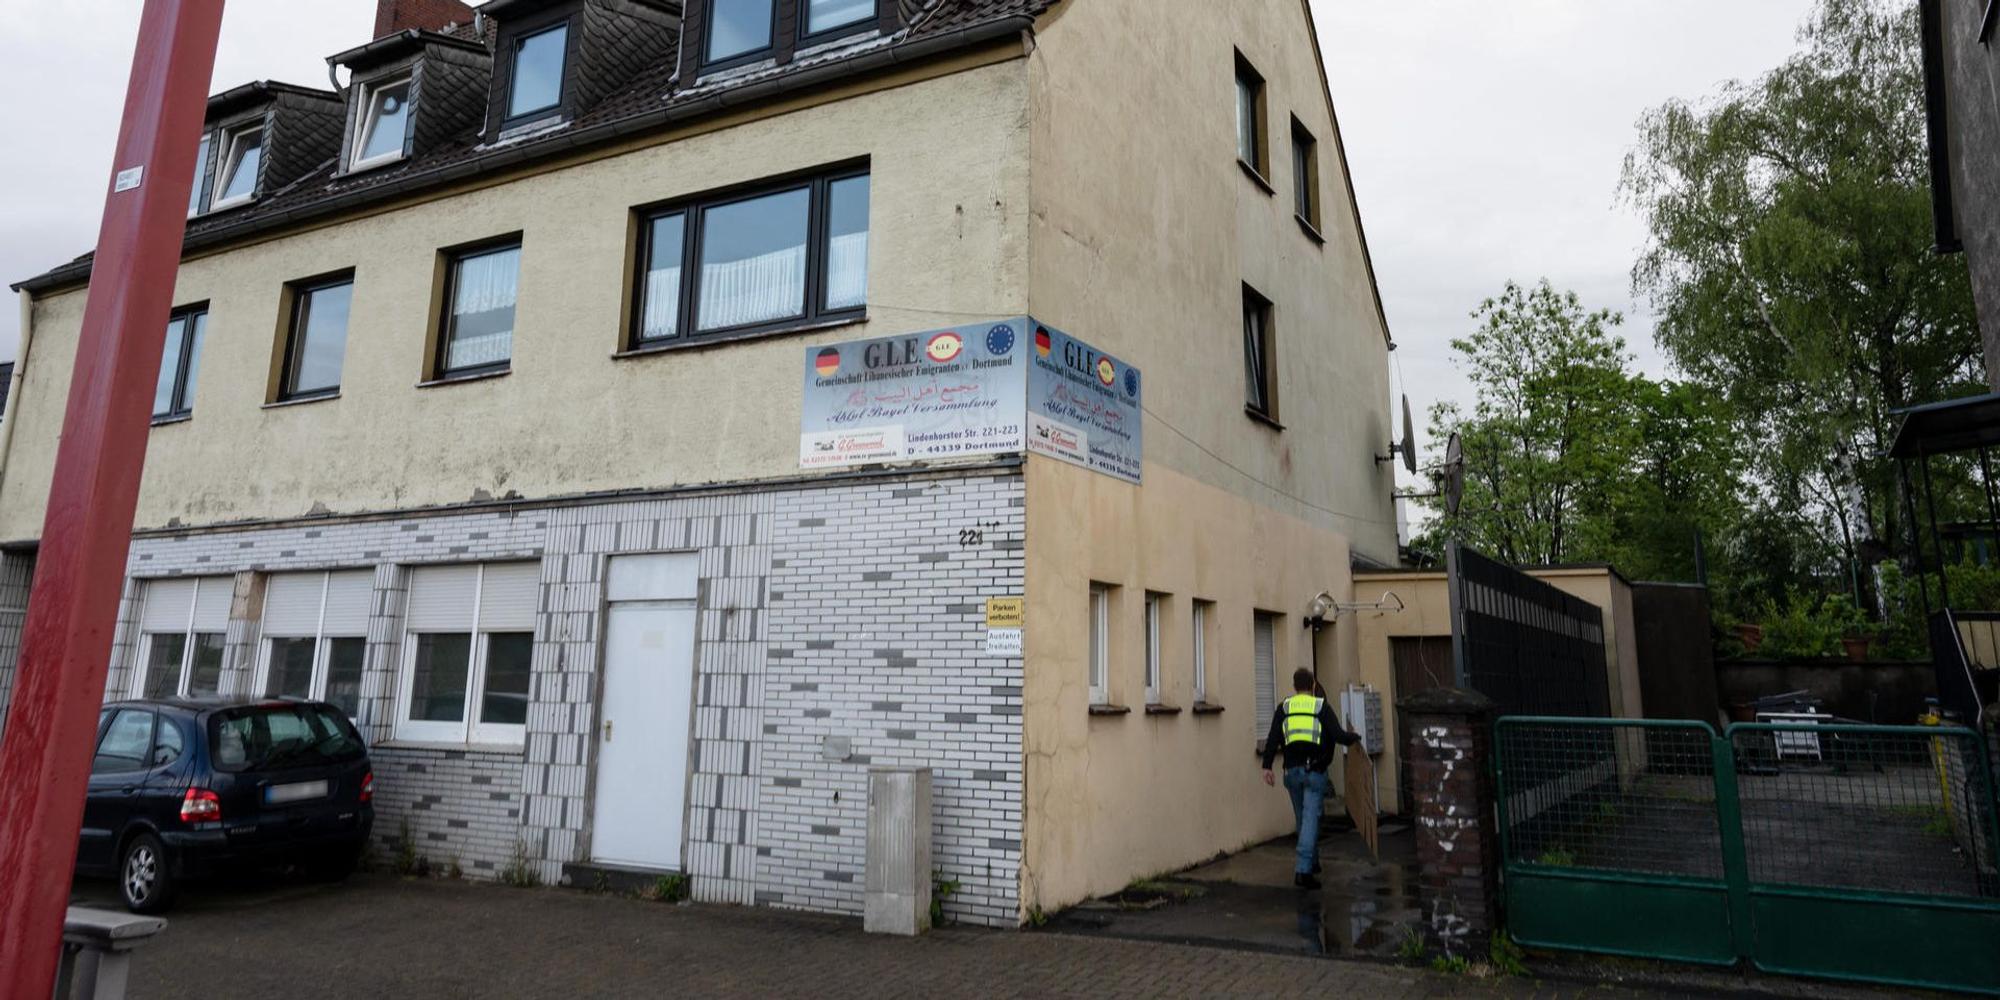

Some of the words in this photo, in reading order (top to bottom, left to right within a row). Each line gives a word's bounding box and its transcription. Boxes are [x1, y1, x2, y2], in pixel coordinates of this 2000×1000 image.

[864, 338, 922, 369] G.L.E.
[815, 372, 862, 388] Gemeinschaft
[864, 367, 913, 382] Libanesischer
[915, 363, 960, 376] Emigranten
[972, 355, 1012, 370] Dortmund
[908, 432, 962, 443] Lindenhorster
[964, 428, 978, 438] Str.
[983, 424, 1018, 437] 221-223
[908, 447, 914, 455] D
[927, 444, 961, 453] 44339
[965, 438, 1019, 450] Dortmund
[989, 613, 1020, 621] verboten!
[989, 632, 1020, 640] Ausfahrt
